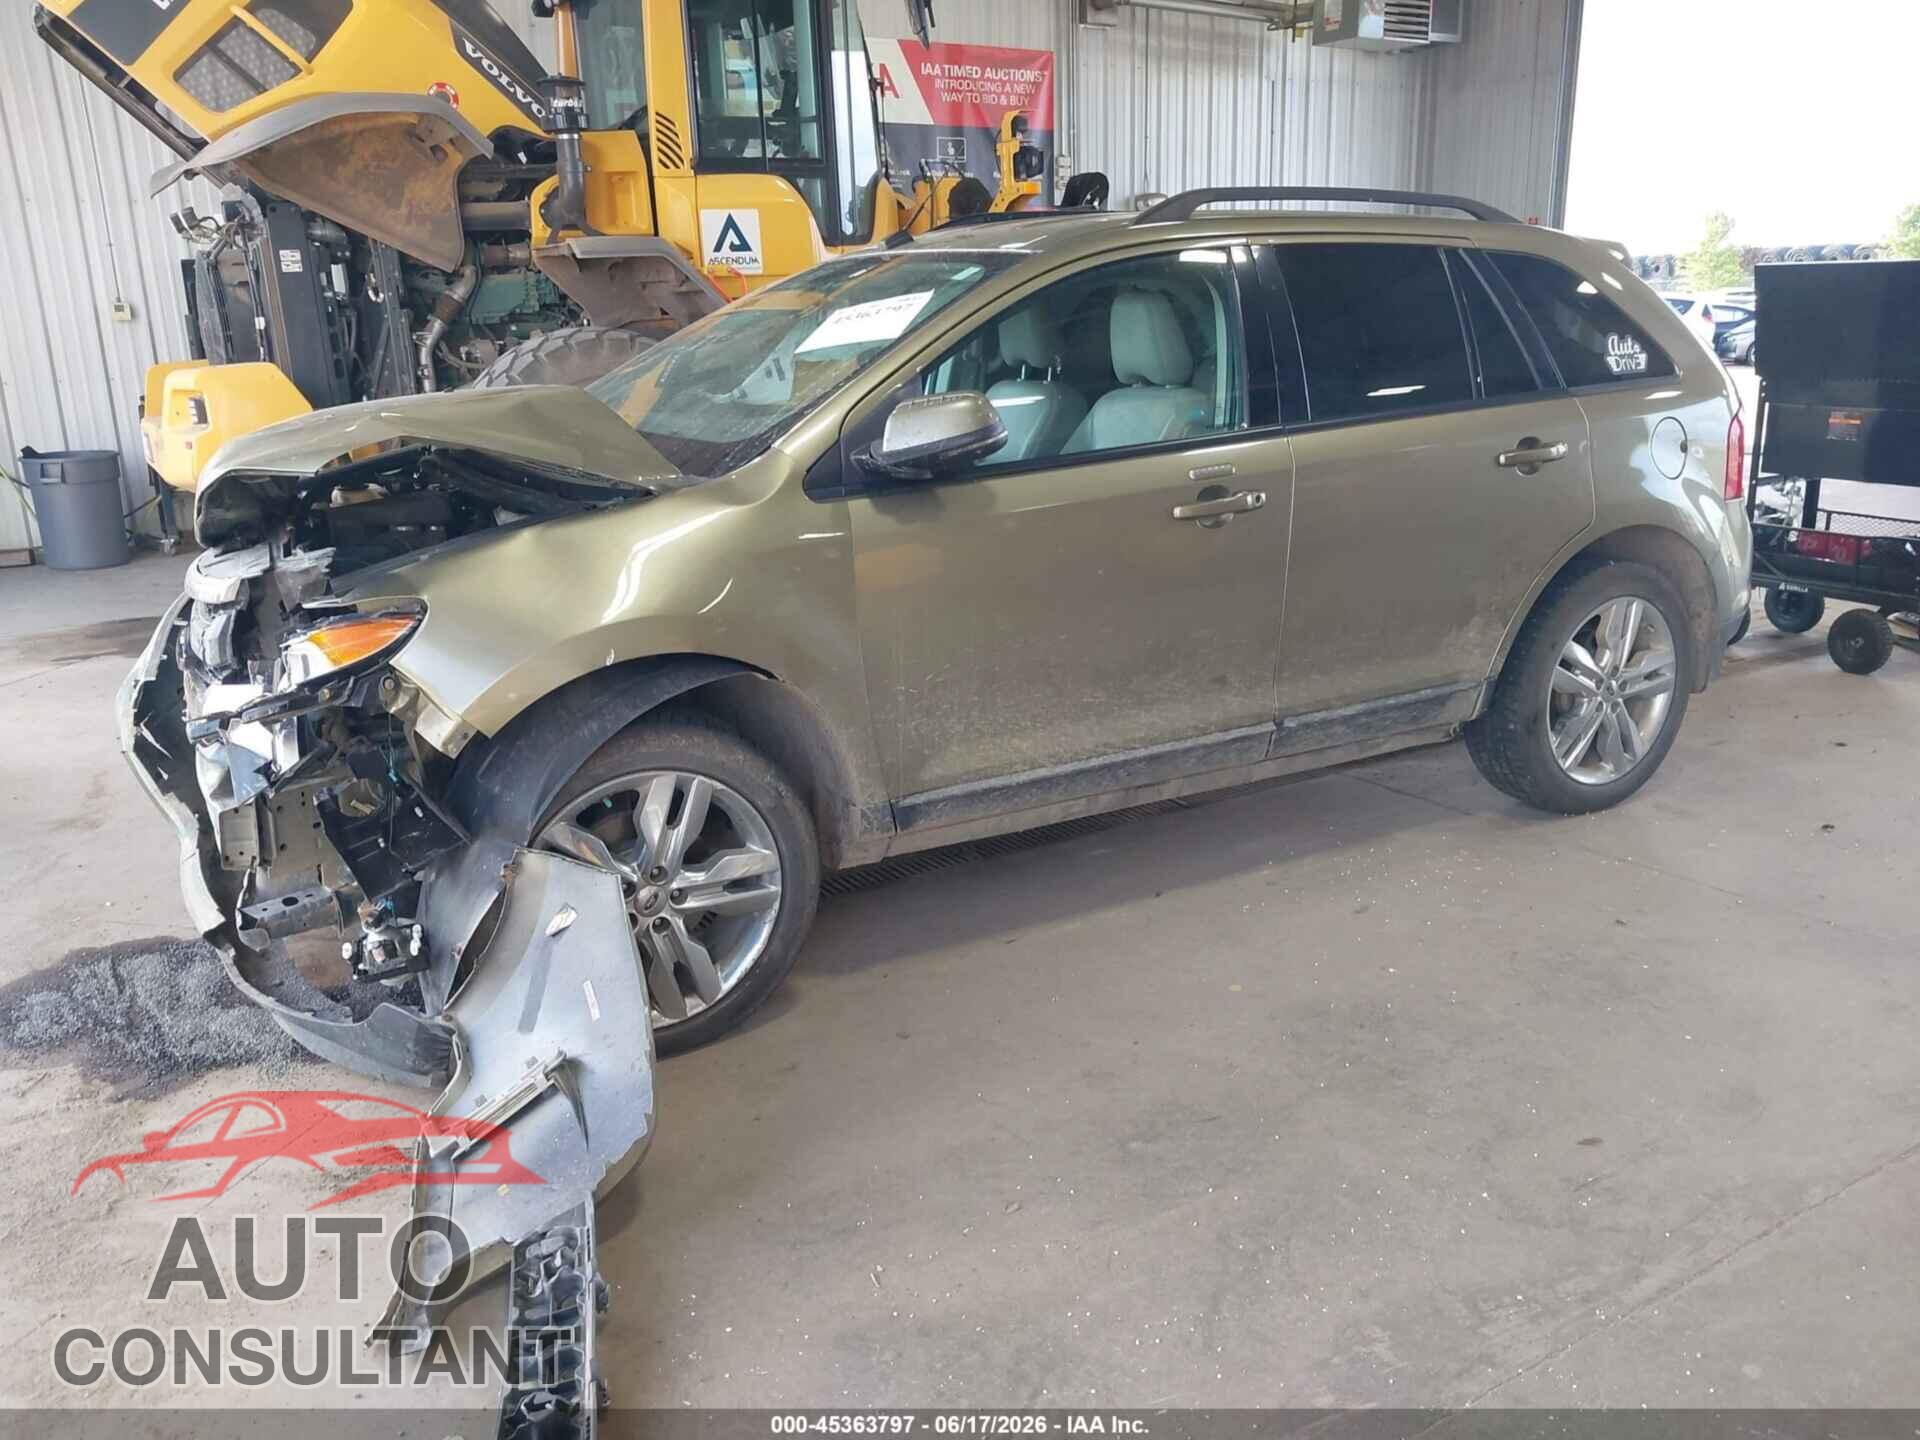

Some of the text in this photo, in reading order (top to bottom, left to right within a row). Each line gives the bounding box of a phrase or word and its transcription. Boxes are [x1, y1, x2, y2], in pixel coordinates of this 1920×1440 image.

[462, 36, 546, 118] VOLVO
[920, 62, 942, 77] IAA
[943, 64, 981, 79] TIMED
[934, 78, 1036, 95] INTRODUCING A NEW
[941, 91, 965, 103] WAY
[966, 92, 981, 104] TO
[983, 94, 998, 105] BID
[1009, 95, 1030, 106] BUY
[708, 256, 760, 265] ASCENDUM
